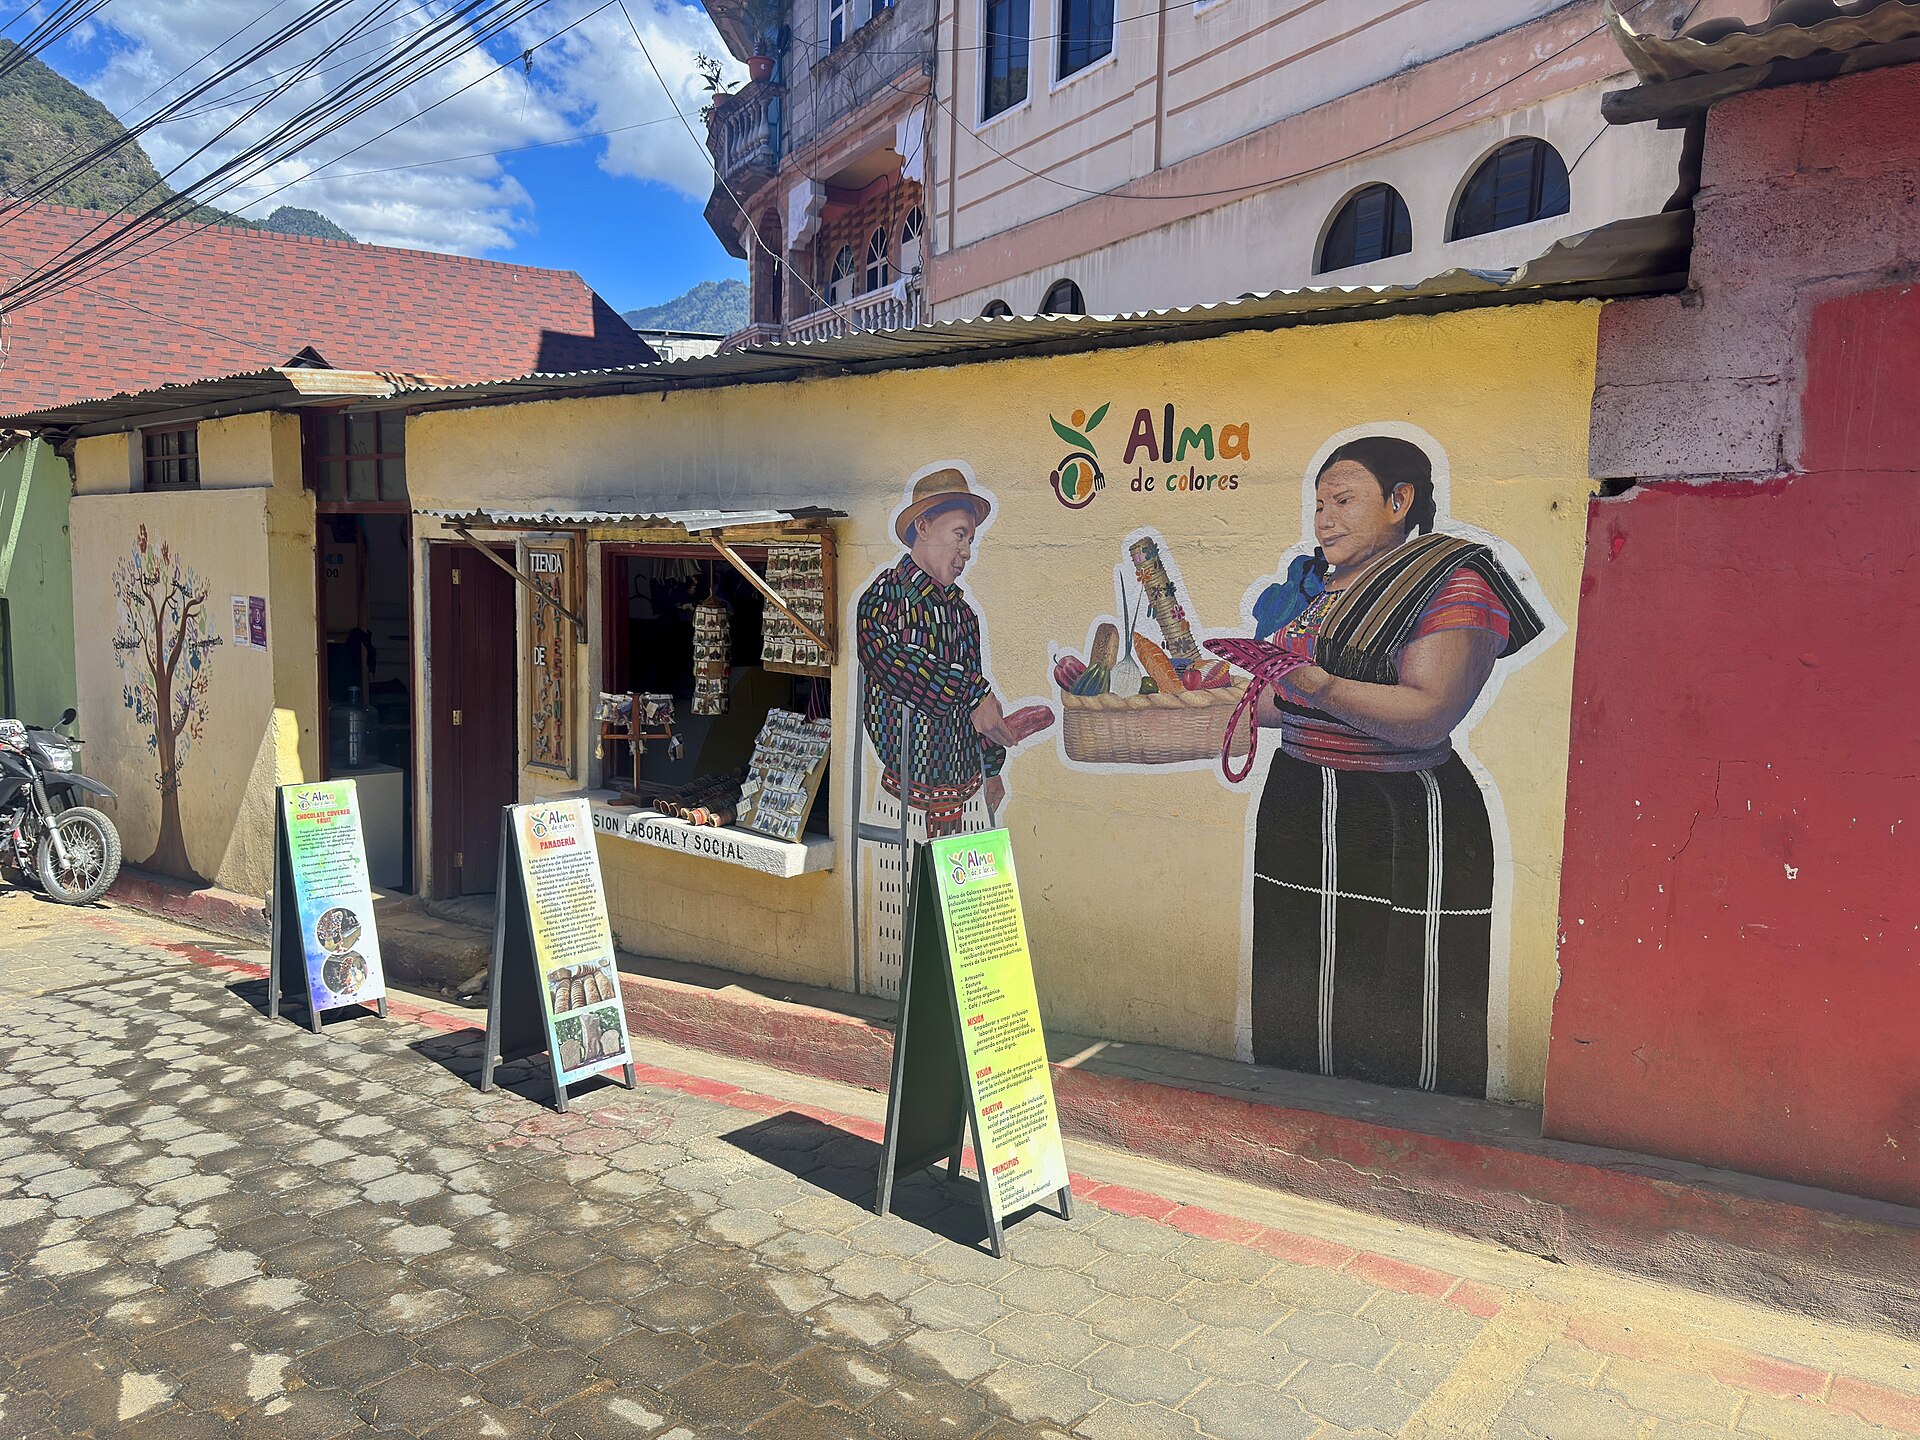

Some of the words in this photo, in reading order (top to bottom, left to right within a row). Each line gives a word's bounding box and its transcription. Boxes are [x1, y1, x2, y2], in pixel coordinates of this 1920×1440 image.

[1123, 403, 1250, 464] Alma
[1131, 466, 1155, 492] de
[1166, 465, 1239, 491] colores
[530, 553, 563, 573] TIENDA
[534, 646, 546, 665] DE
[312, 792, 335, 801] Alma
[549, 811, 575, 824] Alma
[540, 837, 575, 850] PANADERÍA
[624, 819, 677, 845] LABORAL
[681, 831, 688, 848] Y
[695, 835, 744, 860] SOCIAL
[967, 850, 994, 868] Alma
[967, 1014, 984, 1026] MISIÓN
[976, 1066, 992, 1079] VISIÓN
[982, 1101, 1003, 1116] OBJETIVO
[992, 1157, 1019, 1176] PRINCIPIOS
